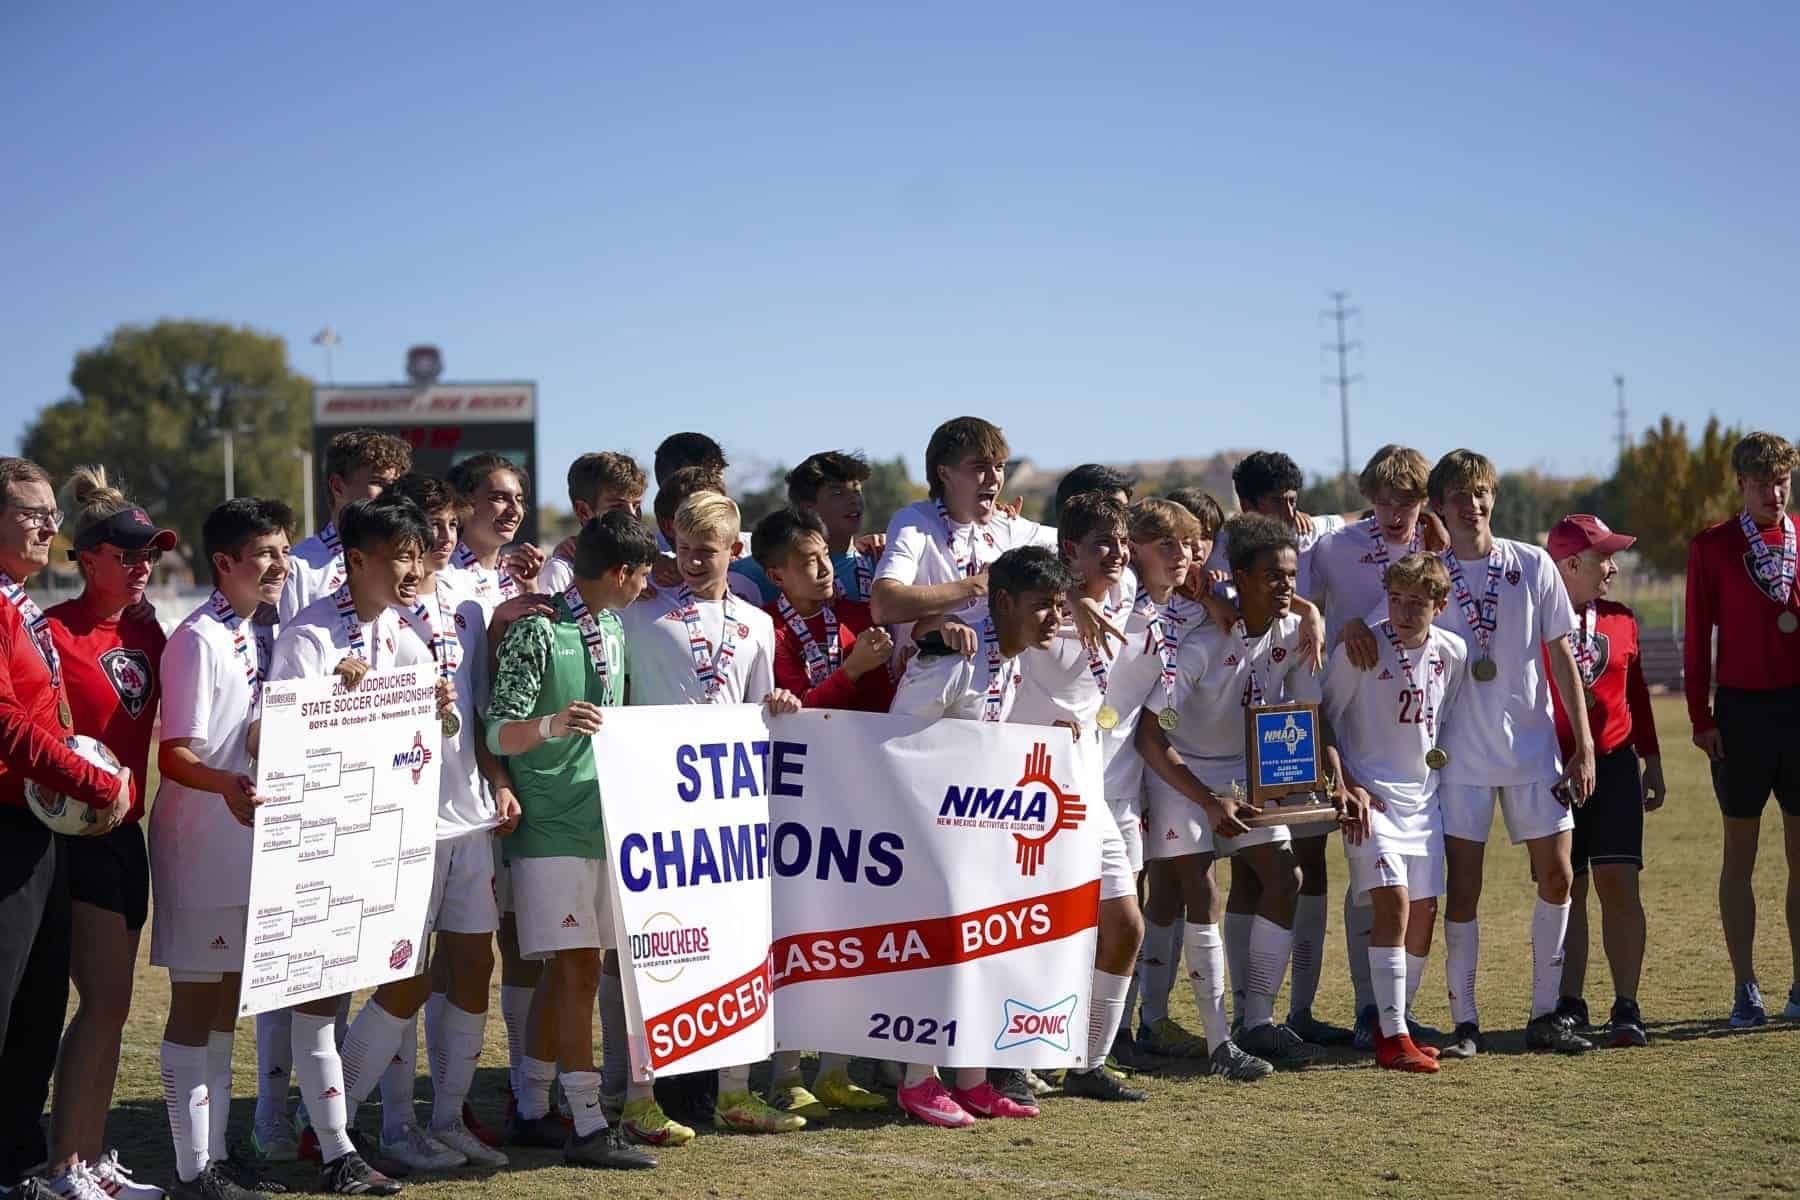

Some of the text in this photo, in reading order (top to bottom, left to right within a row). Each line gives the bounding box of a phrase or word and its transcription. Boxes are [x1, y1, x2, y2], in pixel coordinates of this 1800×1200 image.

[352, 672, 417, 693] UDDRUCKERS
[301, 700, 332, 717] STATE
[334, 695, 372, 713] SOCCER
[309, 719, 328, 730] BOYS
[329, 718, 338, 727] 4A
[341, 715, 367, 726] October
[381, 709, 410, 720] November
[1264, 728, 1296, 741] NMAA
[392, 750, 421, 768] NMAA
[676, 741, 808, 803] STATE
[938, 785, 1048, 822] NMAA
[936, 817, 1045, 832] NEW MEXICO ACTIVITIES ASSOCIATION
[652, 903, 1051, 1058] SOCCER LASS 4A BOYS
[868, 1013, 958, 1047] 2021
[1008, 1014, 1067, 1034] SONIC
